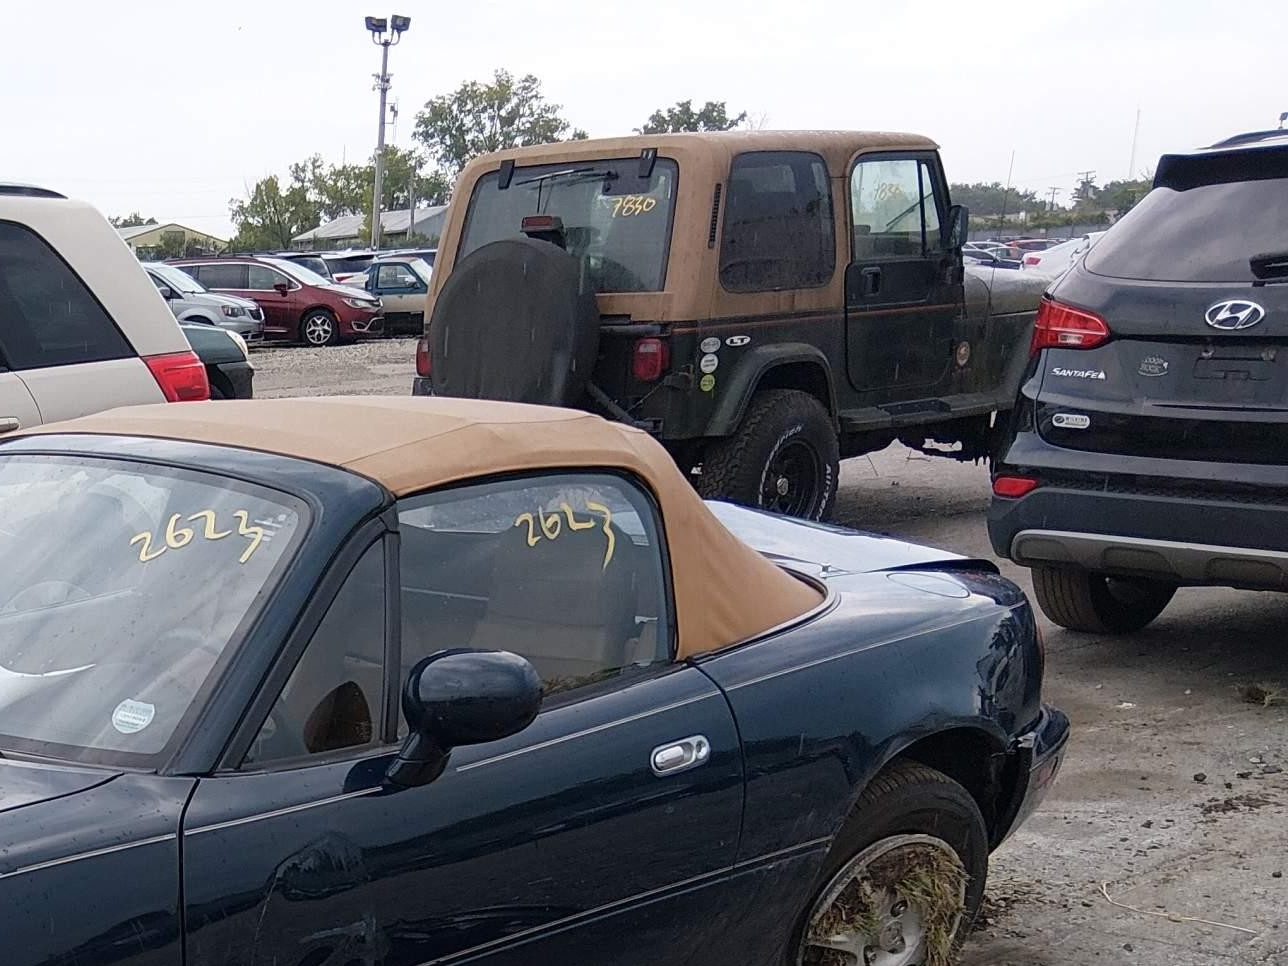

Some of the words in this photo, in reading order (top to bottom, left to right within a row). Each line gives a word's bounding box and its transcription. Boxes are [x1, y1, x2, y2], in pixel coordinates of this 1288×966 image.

[609, 194, 656, 217] 7830
[130, 509, 262, 563] 2623
[514, 502, 615, 573] 2623
